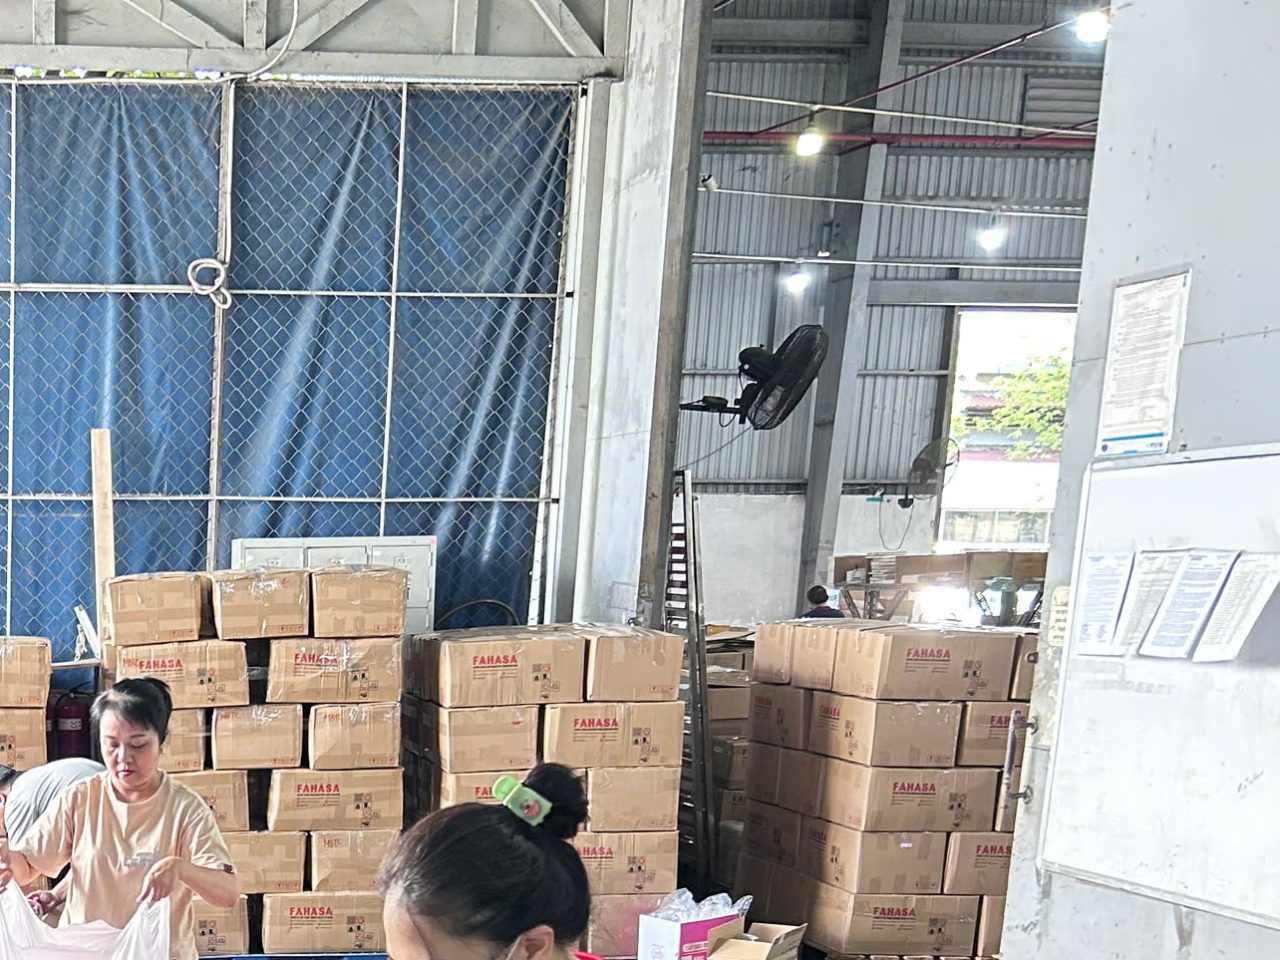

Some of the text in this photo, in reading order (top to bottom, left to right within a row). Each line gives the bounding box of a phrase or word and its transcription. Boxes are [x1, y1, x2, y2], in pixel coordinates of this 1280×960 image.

[905, 648, 951, 660] FAHASA
[139, 659, 183, 670] FAHASA
[473, 655, 518, 666] FAHASA
[573, 718, 619, 728] FAHASA
[296, 784, 340, 794] FAHASA
[893, 782, 936, 793] FAHASA
[577, 847, 614, 856] AHASA
[976, 845, 1012, 855] FAHAS
[289, 907, 333, 917] FAHASA
[873, 906, 916, 917] FAHASA
